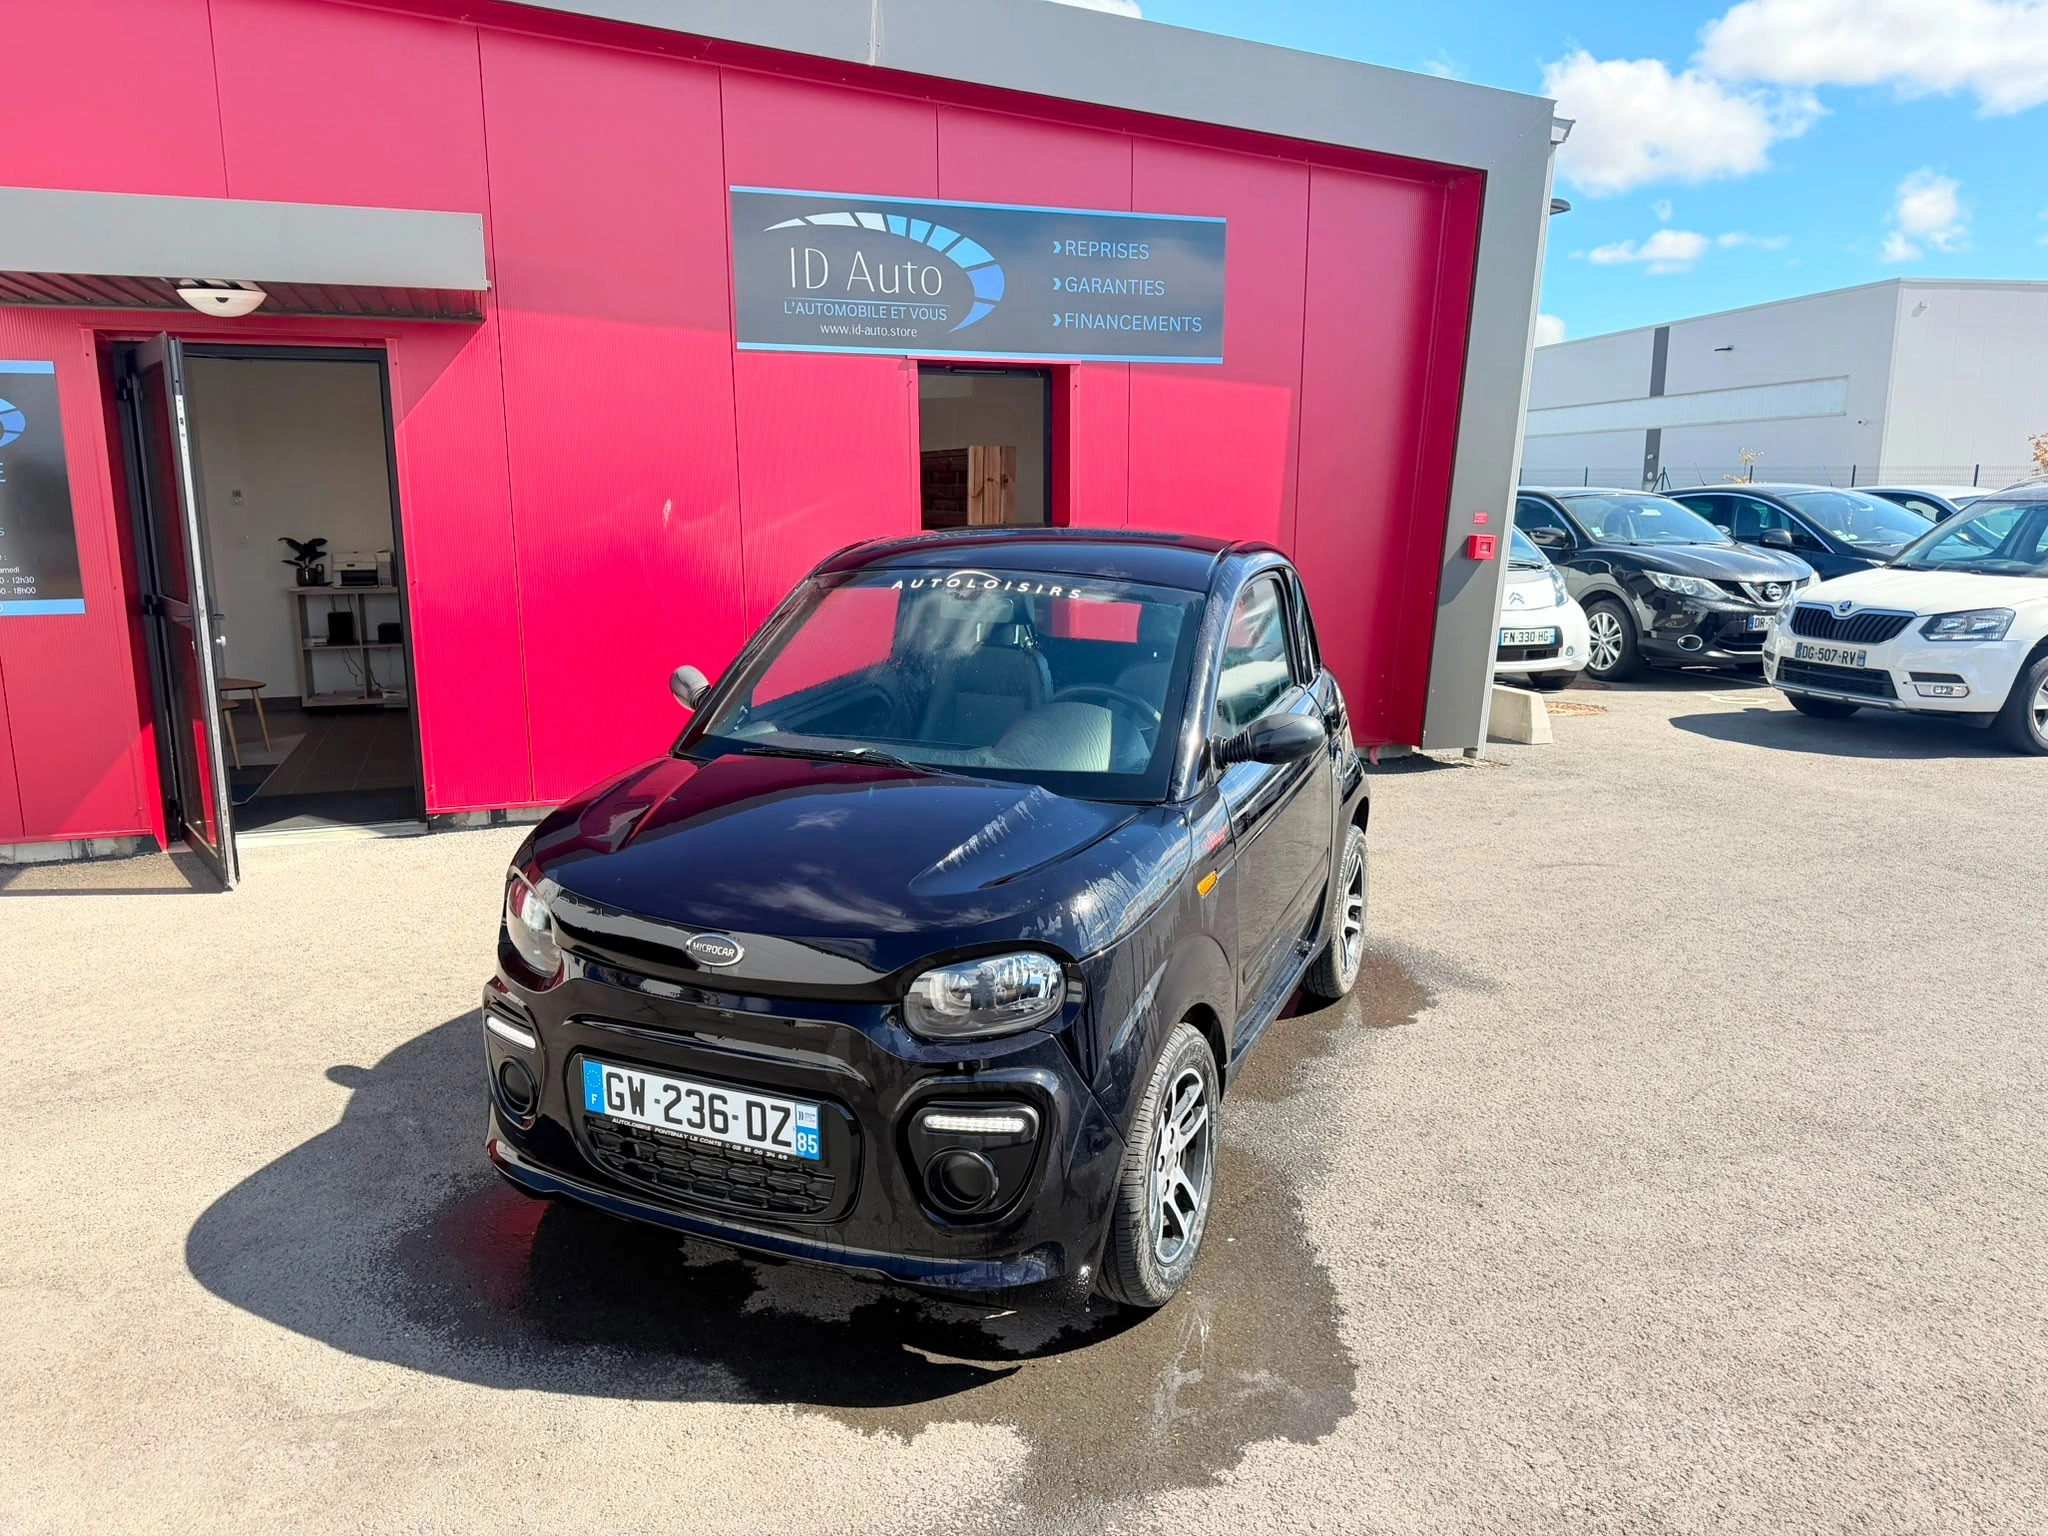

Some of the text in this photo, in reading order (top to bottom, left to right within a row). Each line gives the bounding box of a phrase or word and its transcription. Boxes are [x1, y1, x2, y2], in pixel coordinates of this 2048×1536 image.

[1065, 239, 1150, 260] REPRISES
[790, 247, 942, 296] ID Auto
[1065, 276, 1165, 296] GARANTIES
[891, 306, 907, 320] ET
[909, 307, 948, 321] VOUS
[1064, 312, 1203, 332] FINANCEMENTS
[819, 323, 918, 338] www.id-auto.store
[12, 576, 35, 584] 12h30
[891, 577, 1082, 599] AUTOLOISIRS
[13, 586, 37, 595] 18h00
[692, 941, 735, 957] MICROCAR
[591, 1094, 597, 1104] F
[797, 1131, 817, 1154] 85
